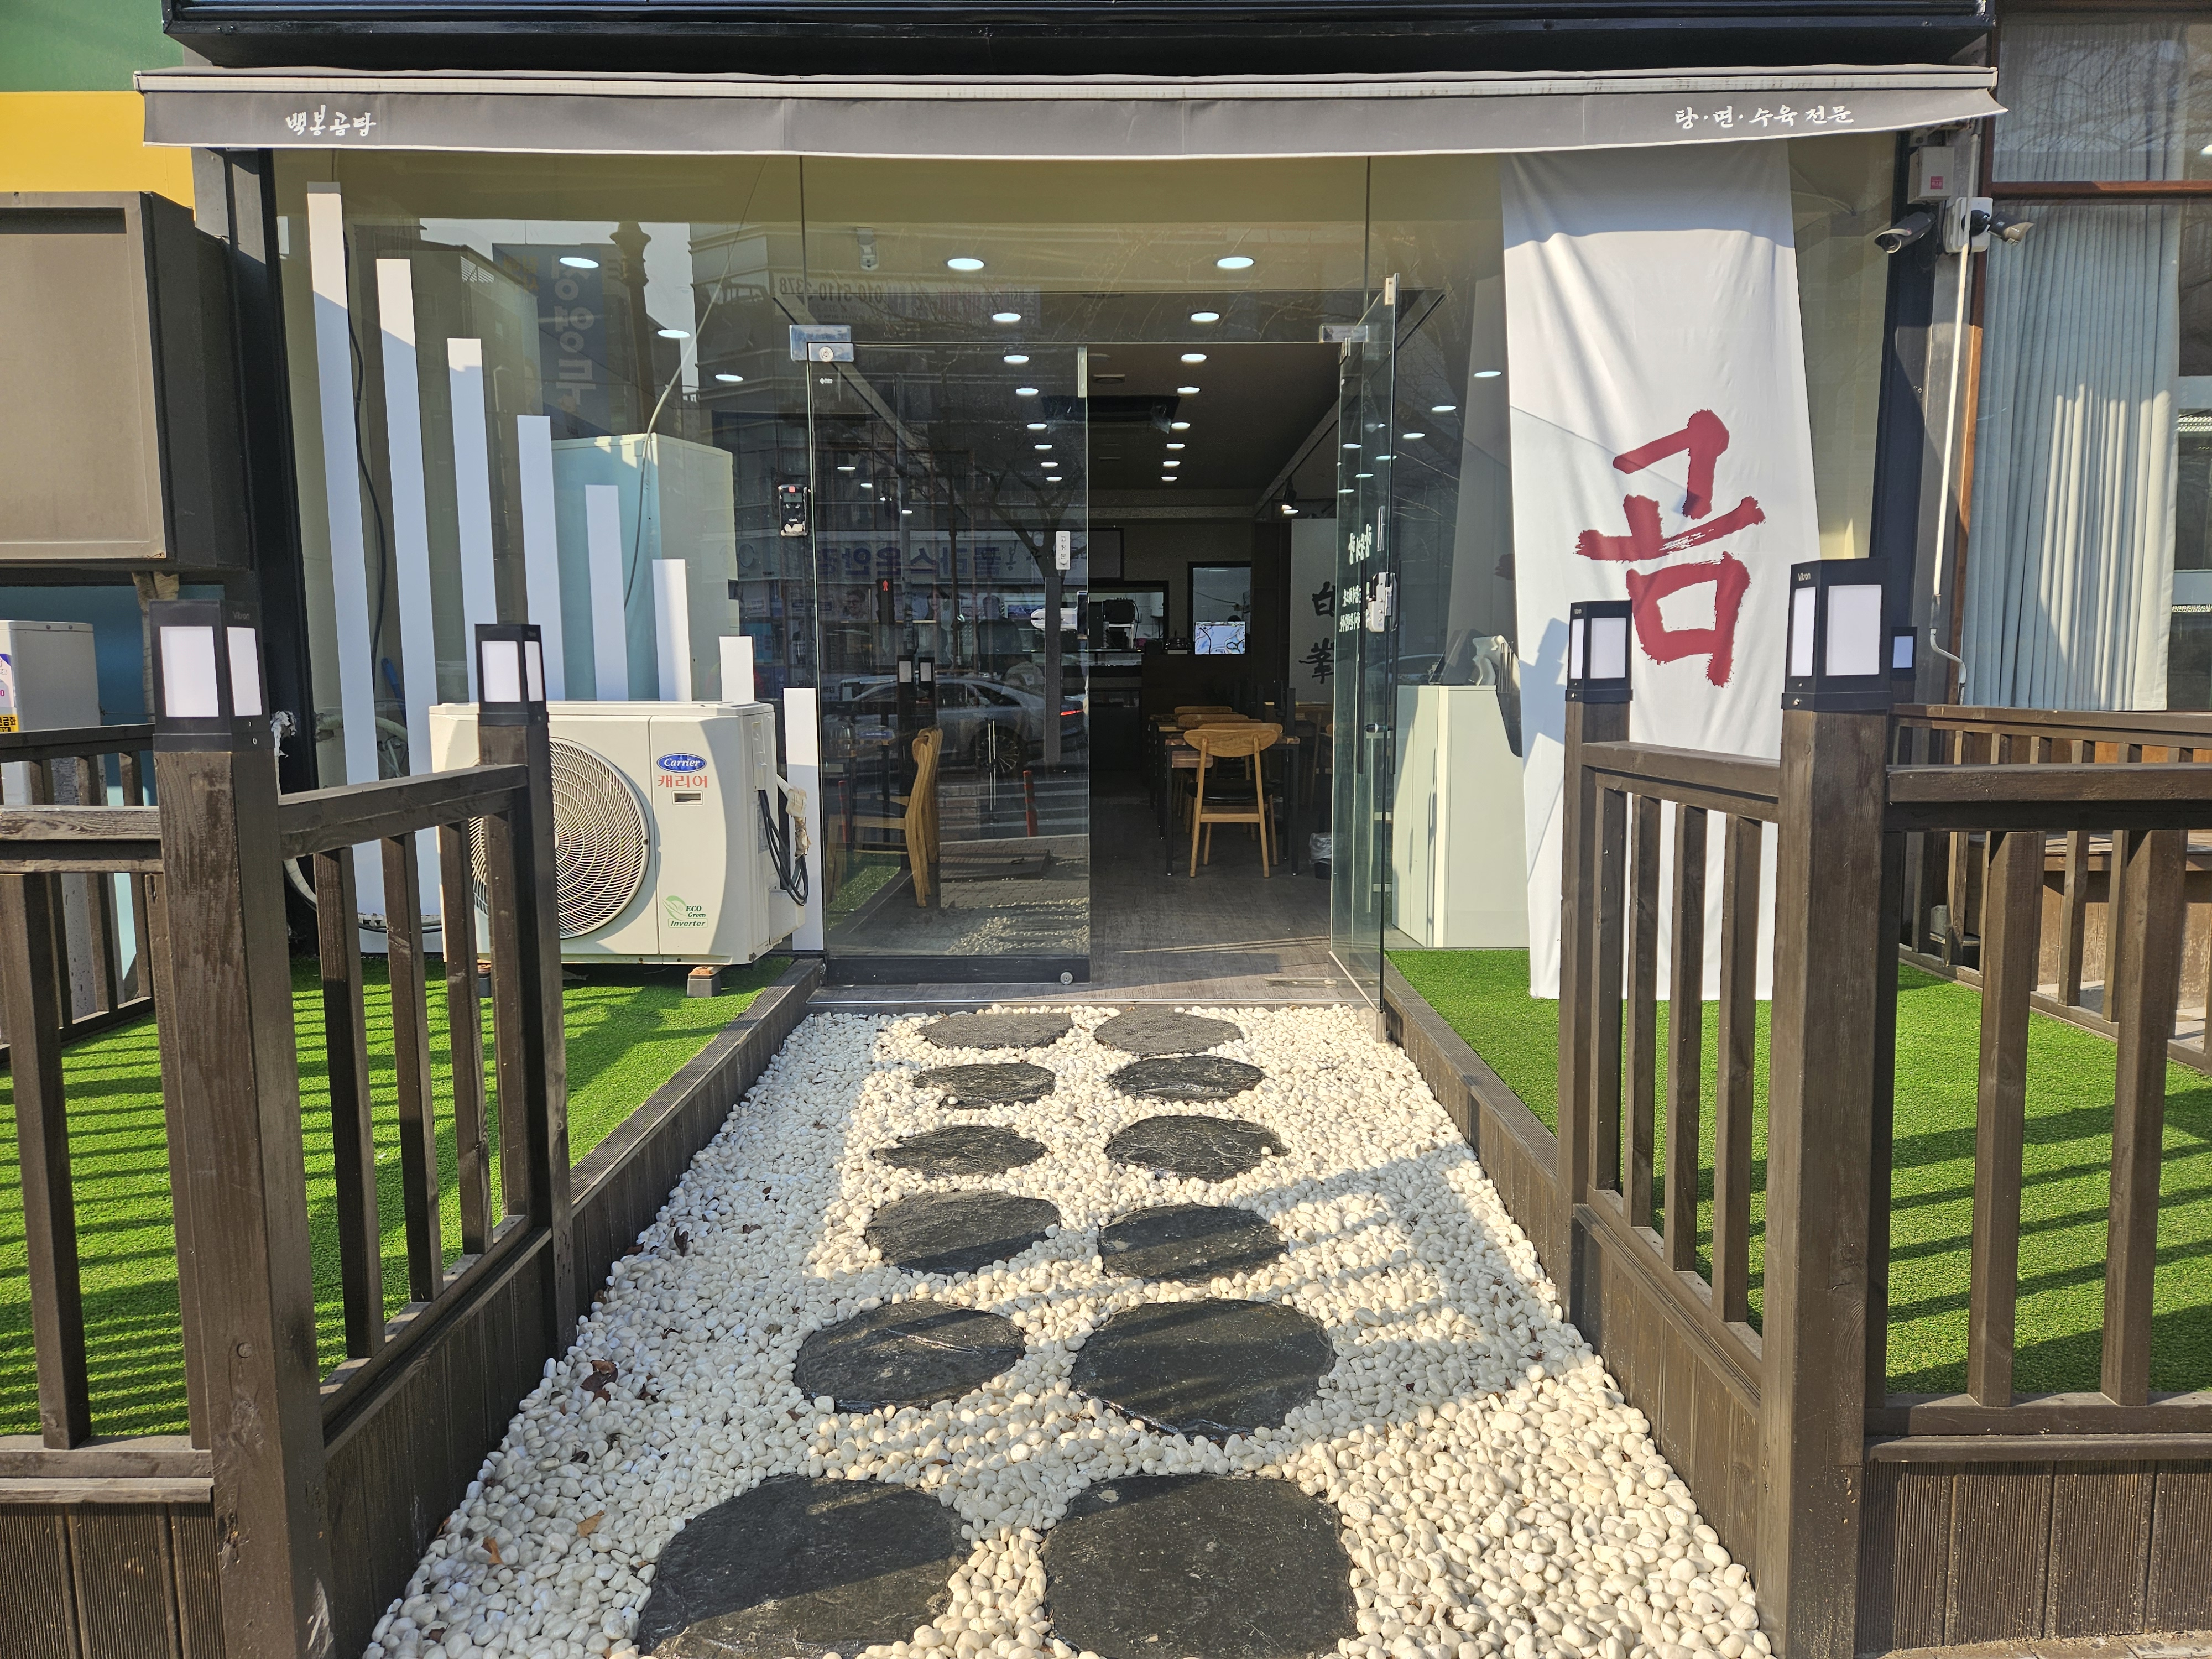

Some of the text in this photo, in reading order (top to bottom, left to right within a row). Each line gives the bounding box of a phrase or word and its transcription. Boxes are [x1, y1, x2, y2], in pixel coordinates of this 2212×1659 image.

[285, 104, 377, 137] 백봉곰탕
[1805, 105, 1854, 124] 전문
[1573, 408, 1766, 687] 곰
[663, 757, 701, 768] Carrier
[658, 775, 708, 788] 캐리어
